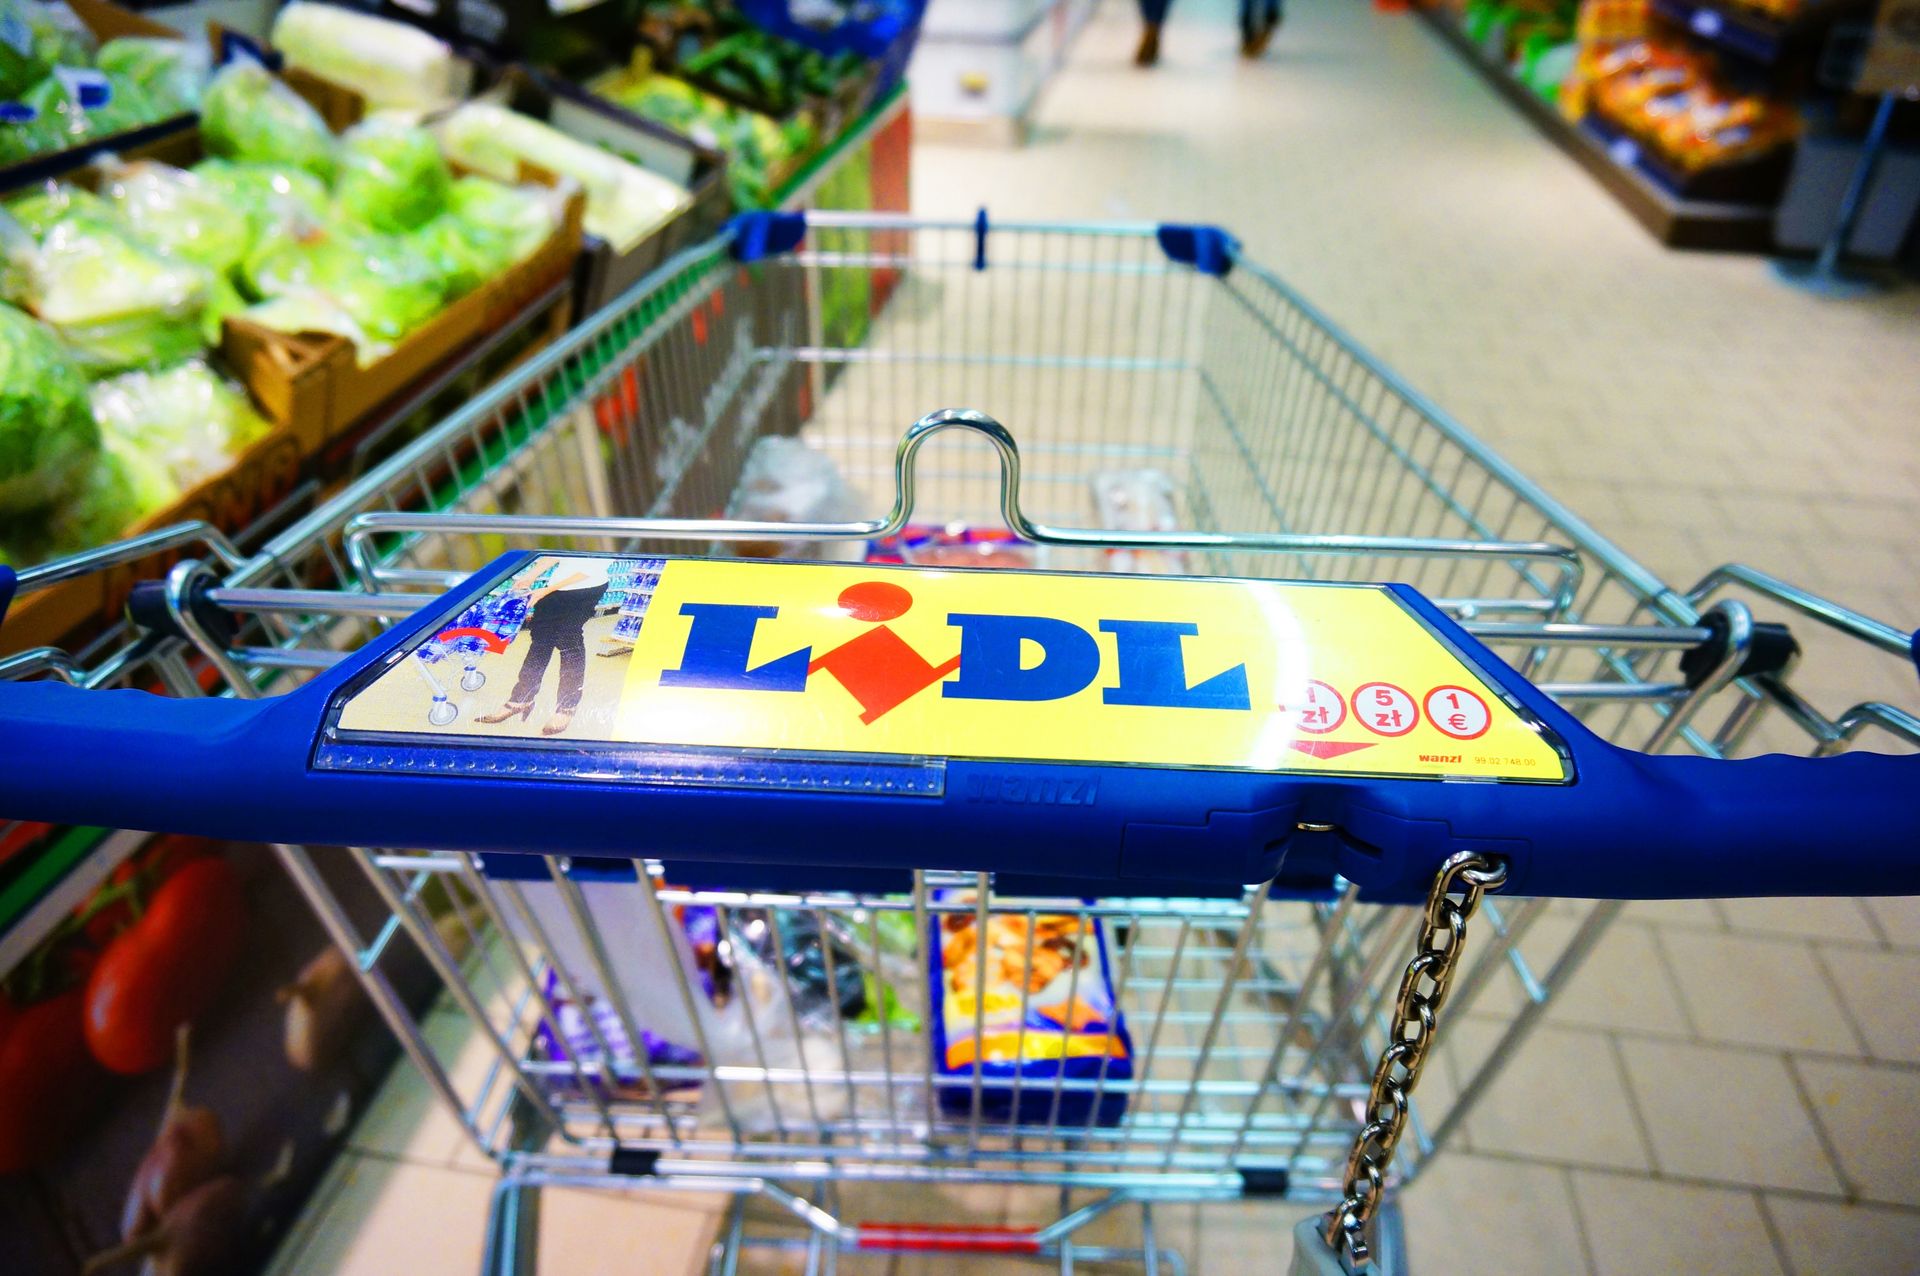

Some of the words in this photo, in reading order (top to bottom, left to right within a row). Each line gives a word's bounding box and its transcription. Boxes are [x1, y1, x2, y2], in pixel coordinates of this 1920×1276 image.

[1375, 689, 1394, 706] 5
[1446, 693, 1460, 710] 1
[1375, 709, 1403, 727] zł
[1447, 713, 1469, 731] €
[1418, 754, 1462, 763] wanzl
